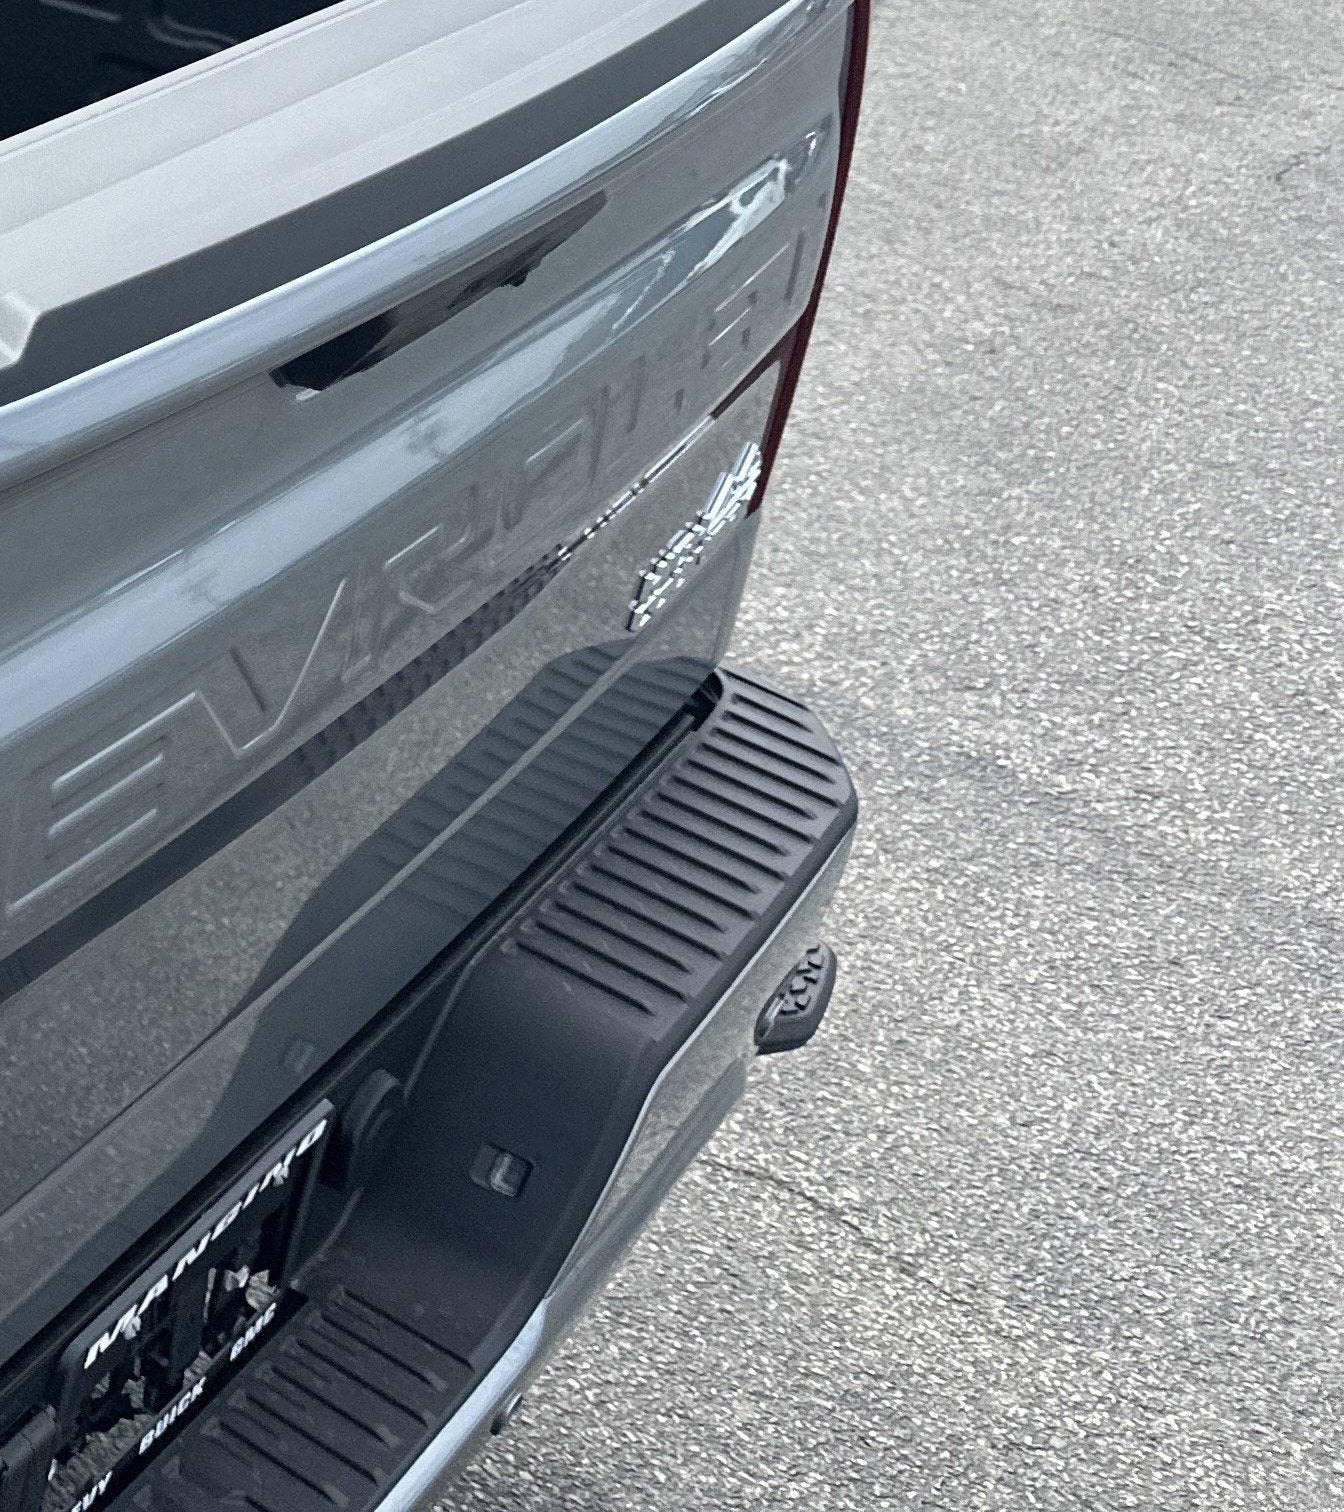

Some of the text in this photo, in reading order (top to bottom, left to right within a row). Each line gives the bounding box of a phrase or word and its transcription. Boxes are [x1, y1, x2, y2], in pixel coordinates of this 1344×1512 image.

[83, 1118, 328, 1369] MANGINO
[138, 1376, 207, 1456] BUICK
[229, 1301, 278, 1363] GMC
